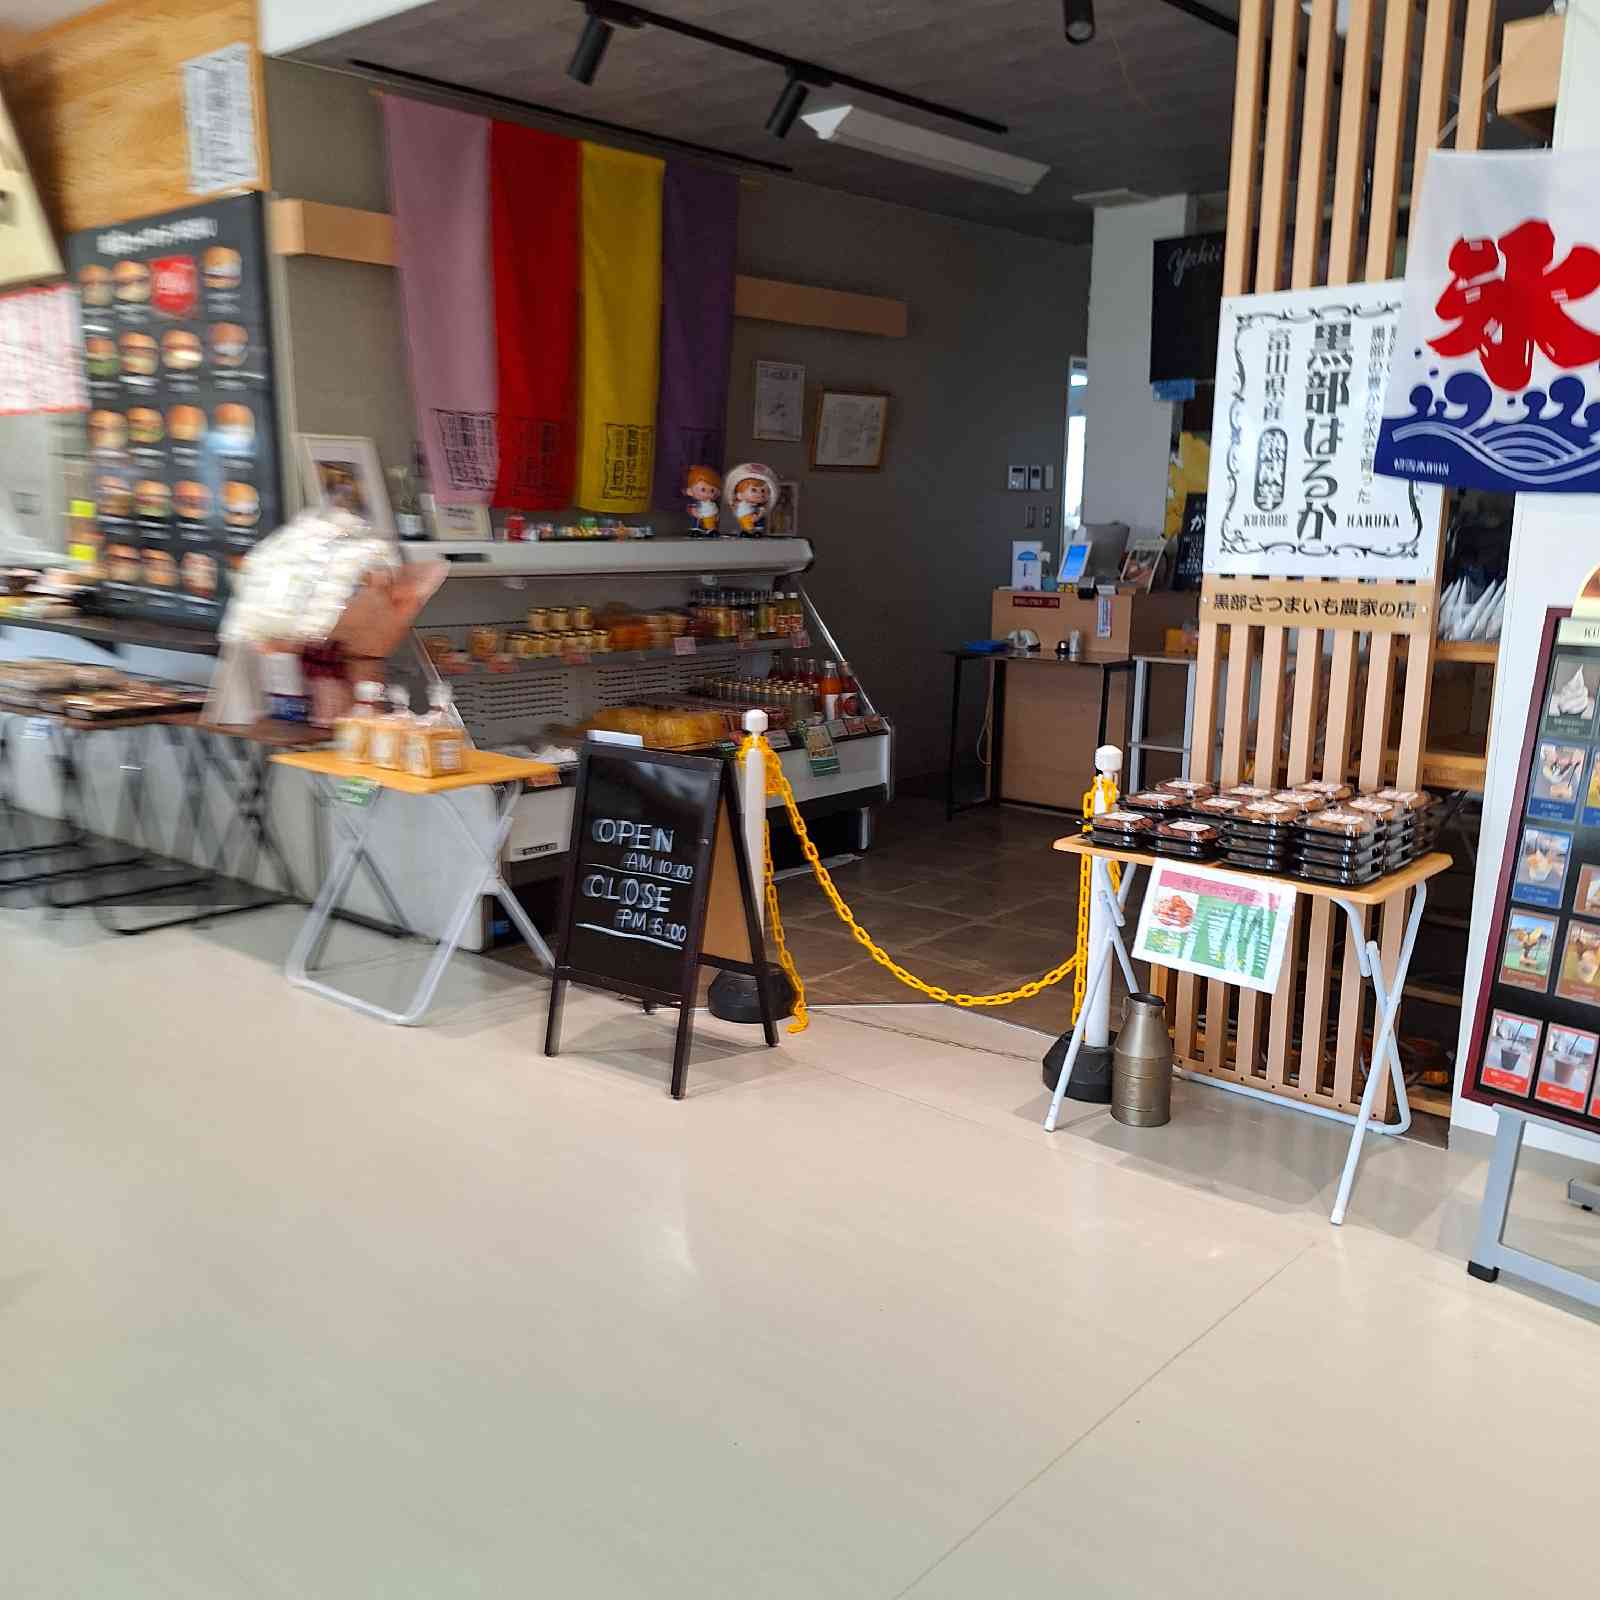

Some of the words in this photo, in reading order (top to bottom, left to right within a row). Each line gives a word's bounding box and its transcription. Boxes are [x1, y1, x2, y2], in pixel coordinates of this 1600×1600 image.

[1427, 218, 1600, 391] 氷
[1297, 322, 1354, 541] 黒部はるか
[1346, 511, 1401, 529] HARUKA
[1213, 593, 1417, 619] 黒部さつまいも農家の店
[592, 818, 675, 853] OPEN
[624, 852, 653, 873] AM
[583, 874, 673, 913] CLOSE
[615, 908, 647, 930] PM
